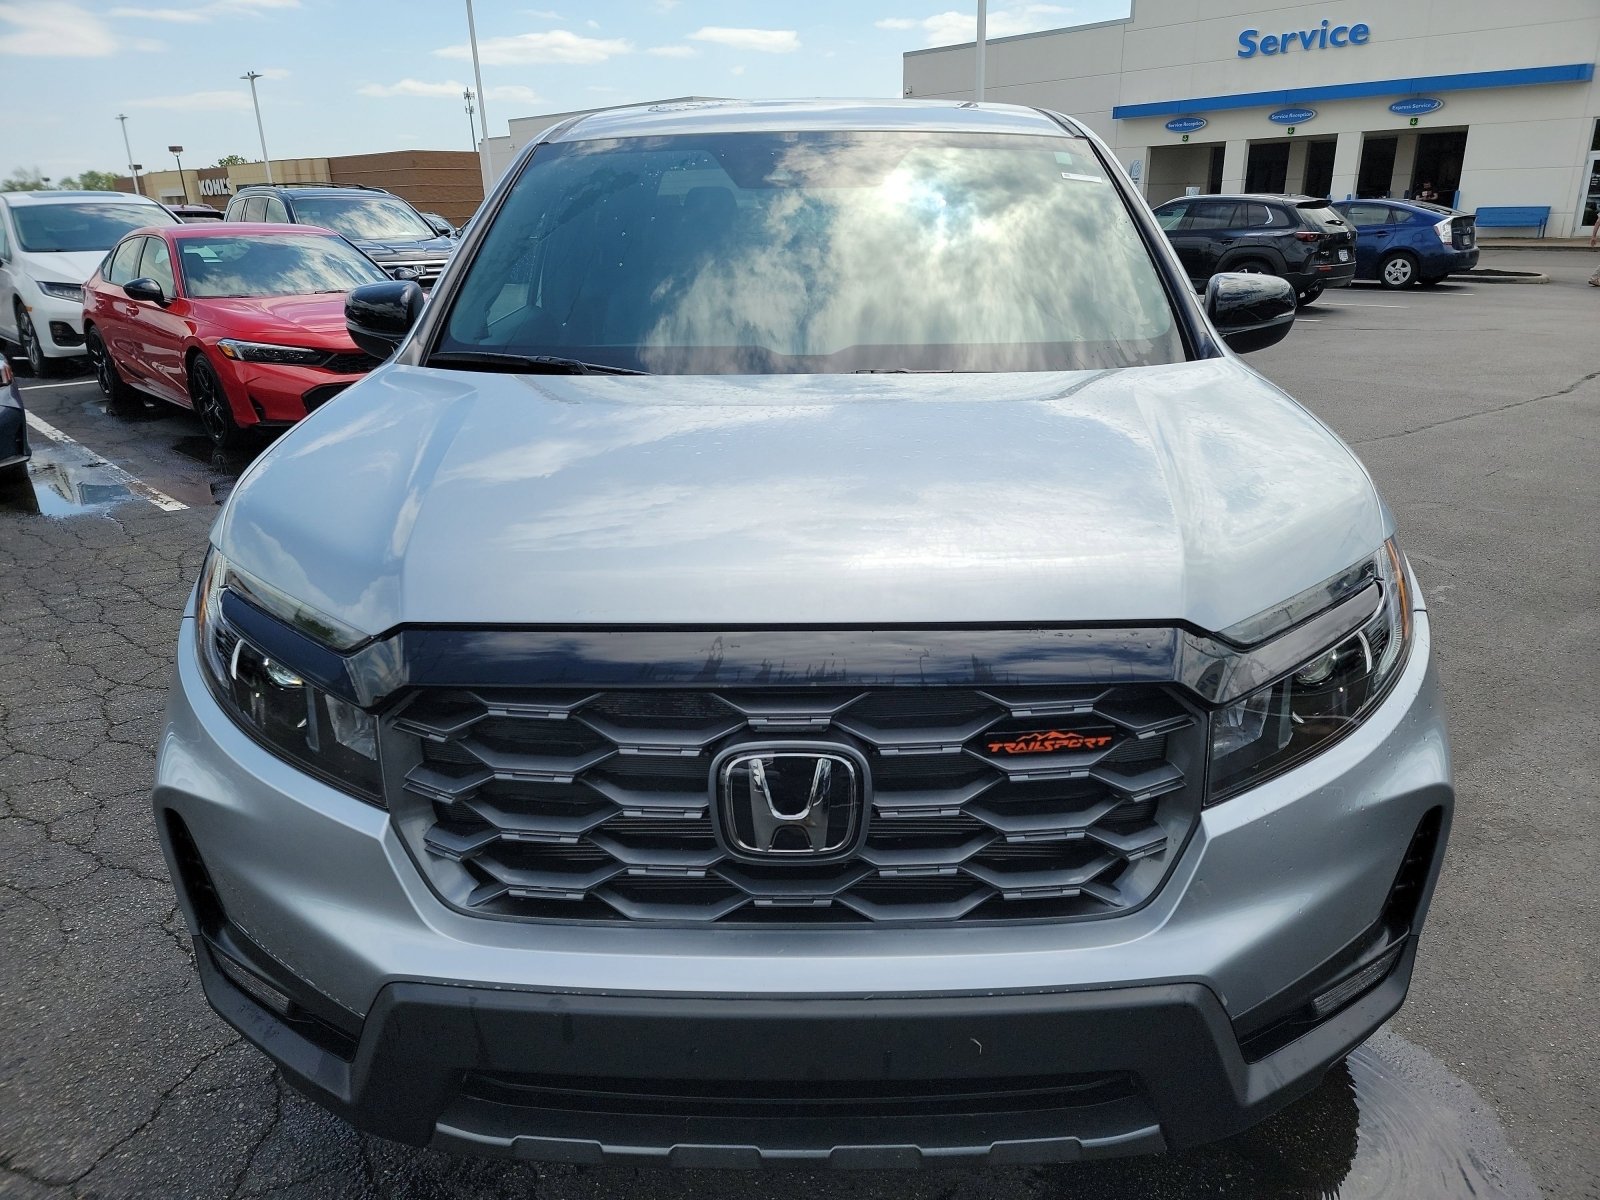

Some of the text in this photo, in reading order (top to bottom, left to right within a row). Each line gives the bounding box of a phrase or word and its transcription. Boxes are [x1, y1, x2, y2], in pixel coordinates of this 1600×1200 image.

[1237, 19, 1370, 59] Service
[198, 177, 232, 196] KOHL'S
[988, 736, 1112, 753] TRAILSPORT
